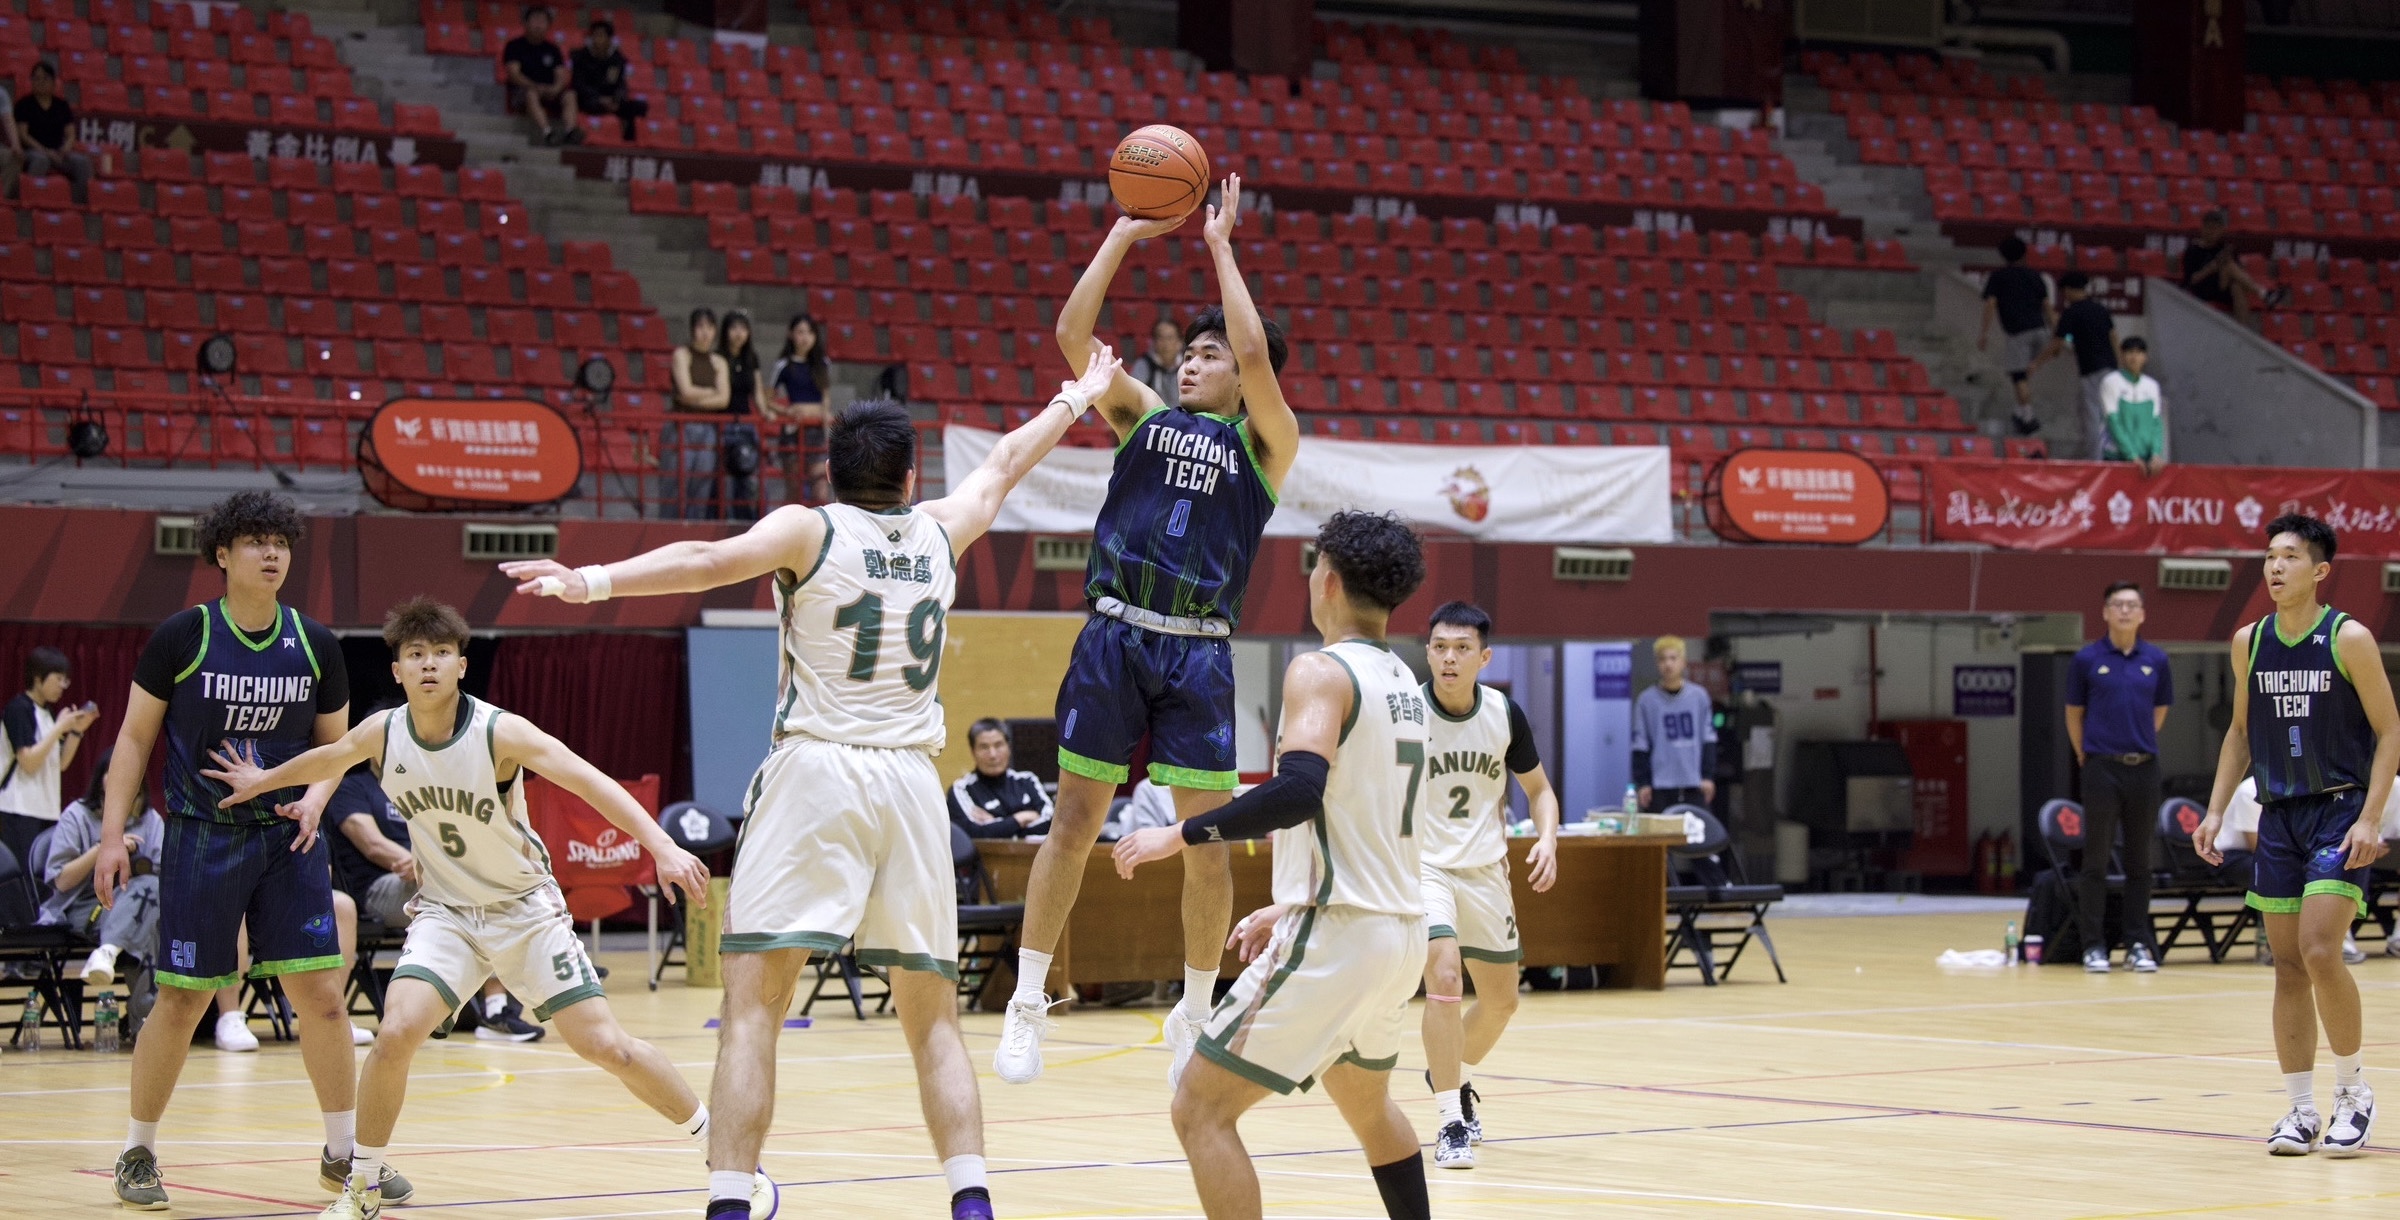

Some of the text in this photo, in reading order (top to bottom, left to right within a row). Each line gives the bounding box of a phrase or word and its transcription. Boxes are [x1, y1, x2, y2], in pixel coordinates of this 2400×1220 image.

[1164, 457, 1220, 495] TECH
[1166, 499, 1192, 537] 0
[2147, 496, 2224, 525] NCKU
[833, 590, 946, 693] 19
[201, 672, 312, 703] TAICHUNG
[2256, 670, 2331, 694] TAICHUNG
[224, 705, 284, 732] TECH
[2273, 695, 2310, 718] TECH
[1663, 711, 1694, 740] 90
[2289, 725, 2302, 757] 9
[1426, 750, 1500, 782] ANUNG
[1395, 738, 1424, 838] 7
[1448, 785, 1470, 819] 2
[438, 821, 467, 858] 5
[567, 840, 639, 862] SPALDING
[1506, 915, 1516, 940] 2
[171, 939, 196, 968] 28
[552, 951, 574, 981] 5
